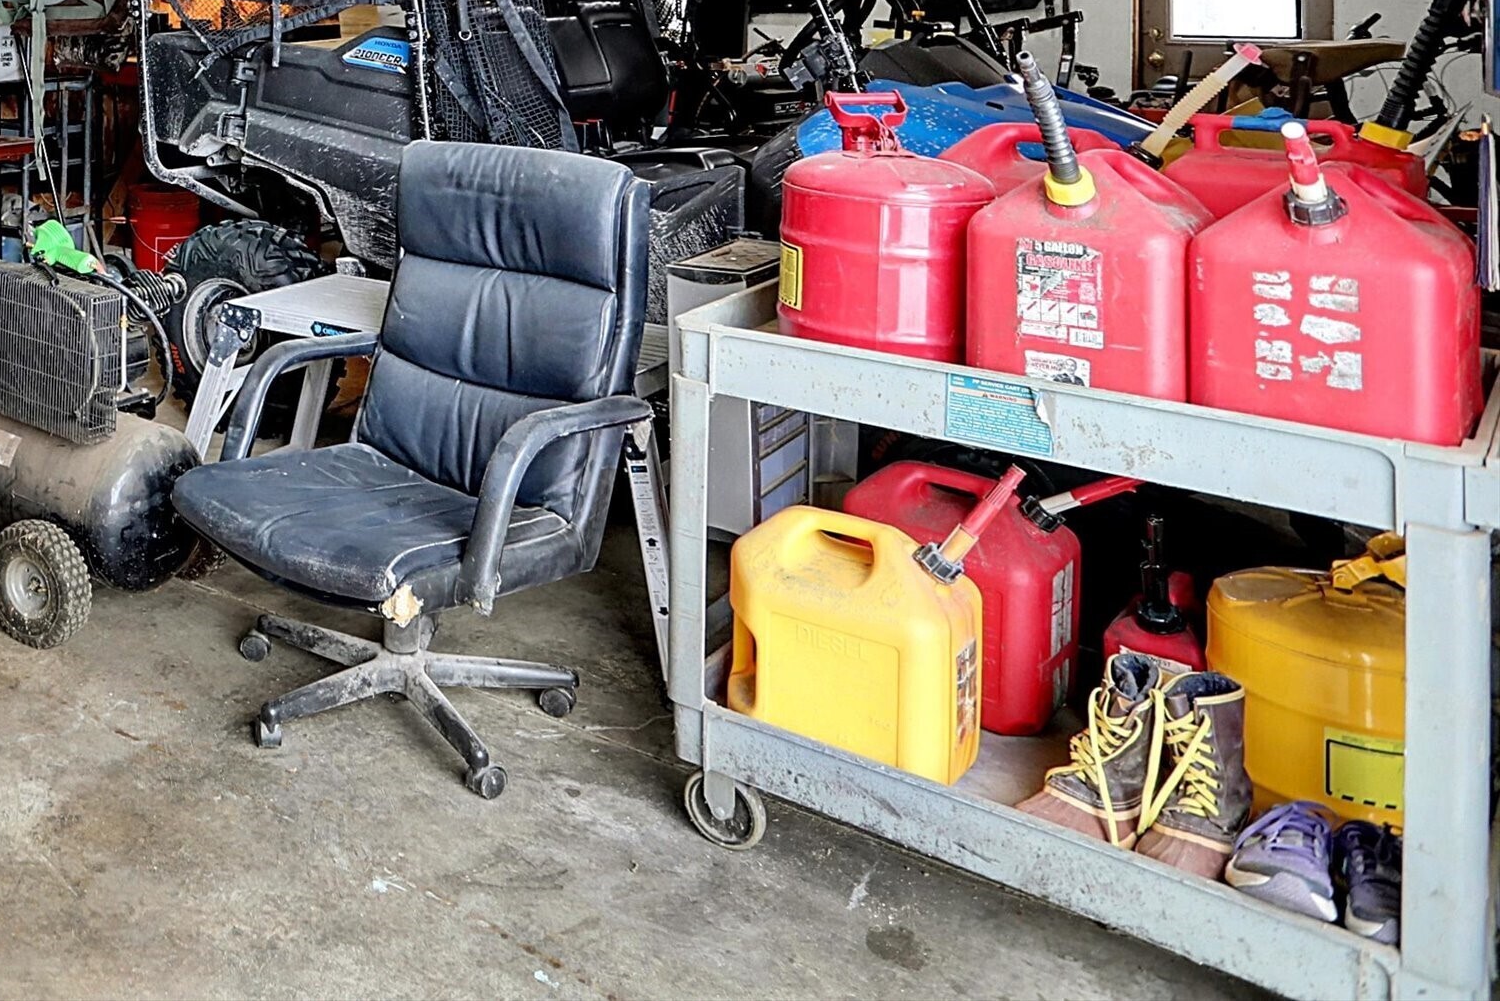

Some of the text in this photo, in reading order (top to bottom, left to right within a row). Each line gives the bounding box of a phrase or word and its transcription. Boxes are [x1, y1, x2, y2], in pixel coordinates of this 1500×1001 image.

[374, 39, 403, 49] HONDA
[354, 48, 403, 64] PIONEER
[1034, 241, 1084, 255] 5 GALLON
[1025, 254, 1095, 273] GASOLINE
[980, 380, 1004, 389] SERVICE
[989, 394, 1018, 402] WARNING
